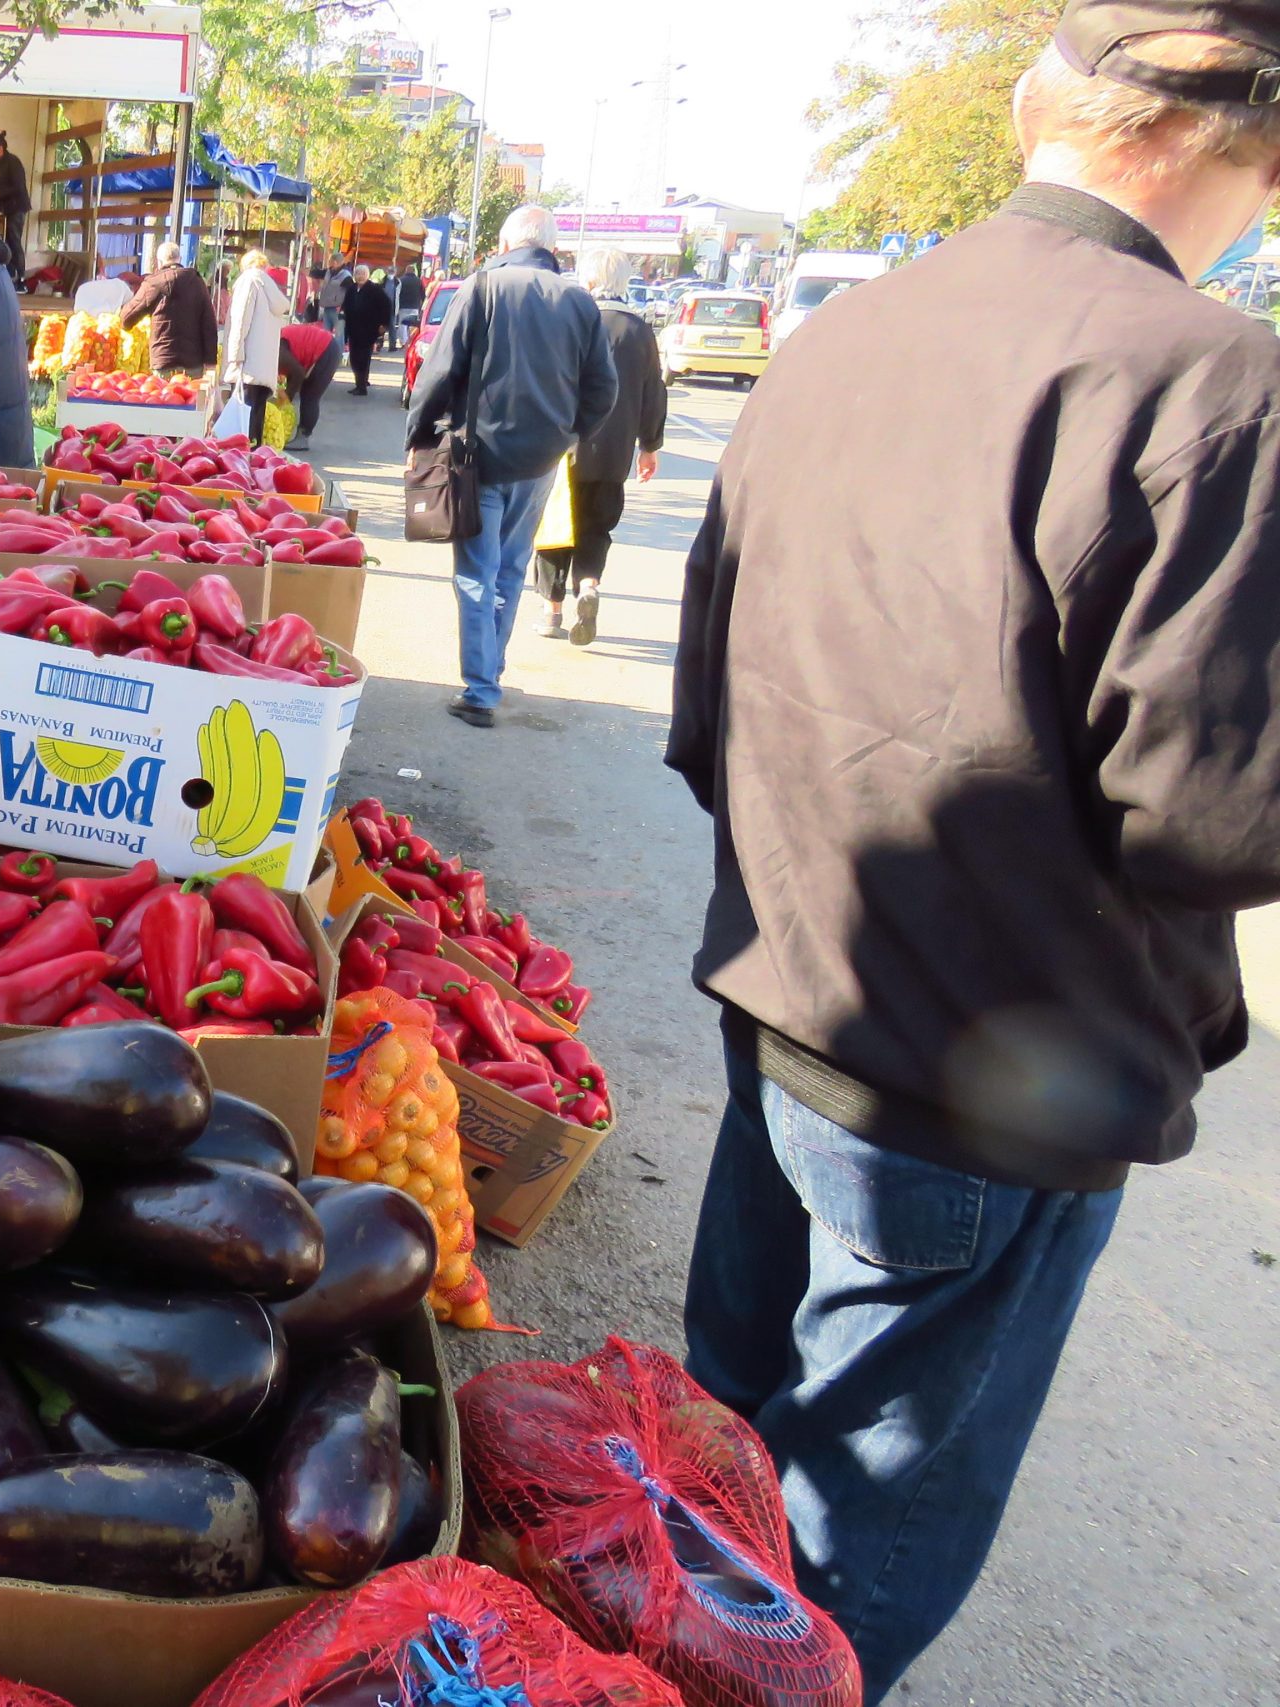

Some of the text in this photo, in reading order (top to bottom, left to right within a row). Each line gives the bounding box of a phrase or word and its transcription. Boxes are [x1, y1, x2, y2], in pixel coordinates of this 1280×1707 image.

[252, 699, 278, 708] QUALITY
[0, 710, 164, 753] PREMIUM BANANAS
[46, 818, 147, 855] PREMIUM
